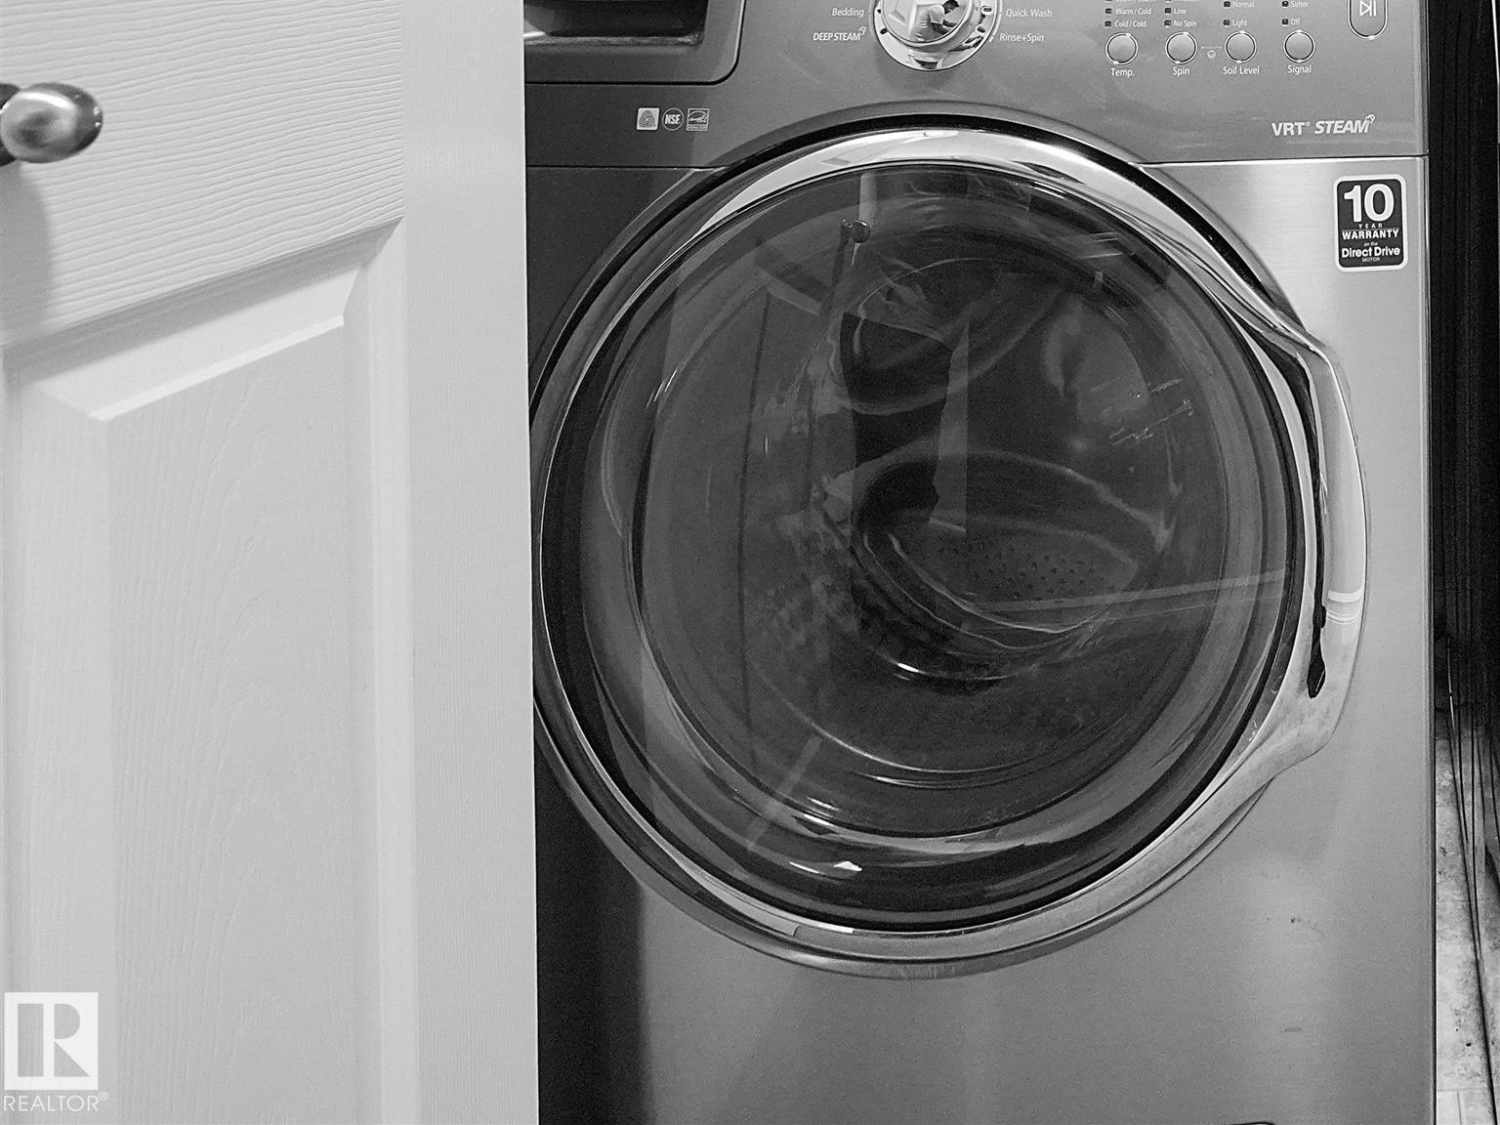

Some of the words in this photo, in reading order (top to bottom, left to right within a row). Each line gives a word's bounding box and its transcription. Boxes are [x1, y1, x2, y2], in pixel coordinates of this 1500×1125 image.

[831, 7, 865, 18] Bedding
[1005, 8, 1029, 18] Quick
[1030, 8, 1053, 18] Wash
[1173, 7, 1187, 15] Low
[1173, 19, 1182, 27] No
[1183, 19, 1198, 28] Spin
[1232, 19, 1248, 28] Light
[1290, 17, 1301, 25] Off
[999, 33, 1045, 43] Rinse+Spin
[1110, 67, 1136, 78] Temp.
[1172, 66, 1191, 78] Spin
[1222, 65, 1238, 75] Soil
[1239, 65, 1260, 75] Level
[1287, 64, 1312, 75] Signal
[664, 113, 681, 125] NSF
[1314, 119, 1370, 135] STEAM
[1343, 183, 1395, 223] 10
[1341, 228, 1400, 240] WARRANTY
[1341, 247, 1373, 258] Direct
[1374, 246, 1401, 257] Drive
